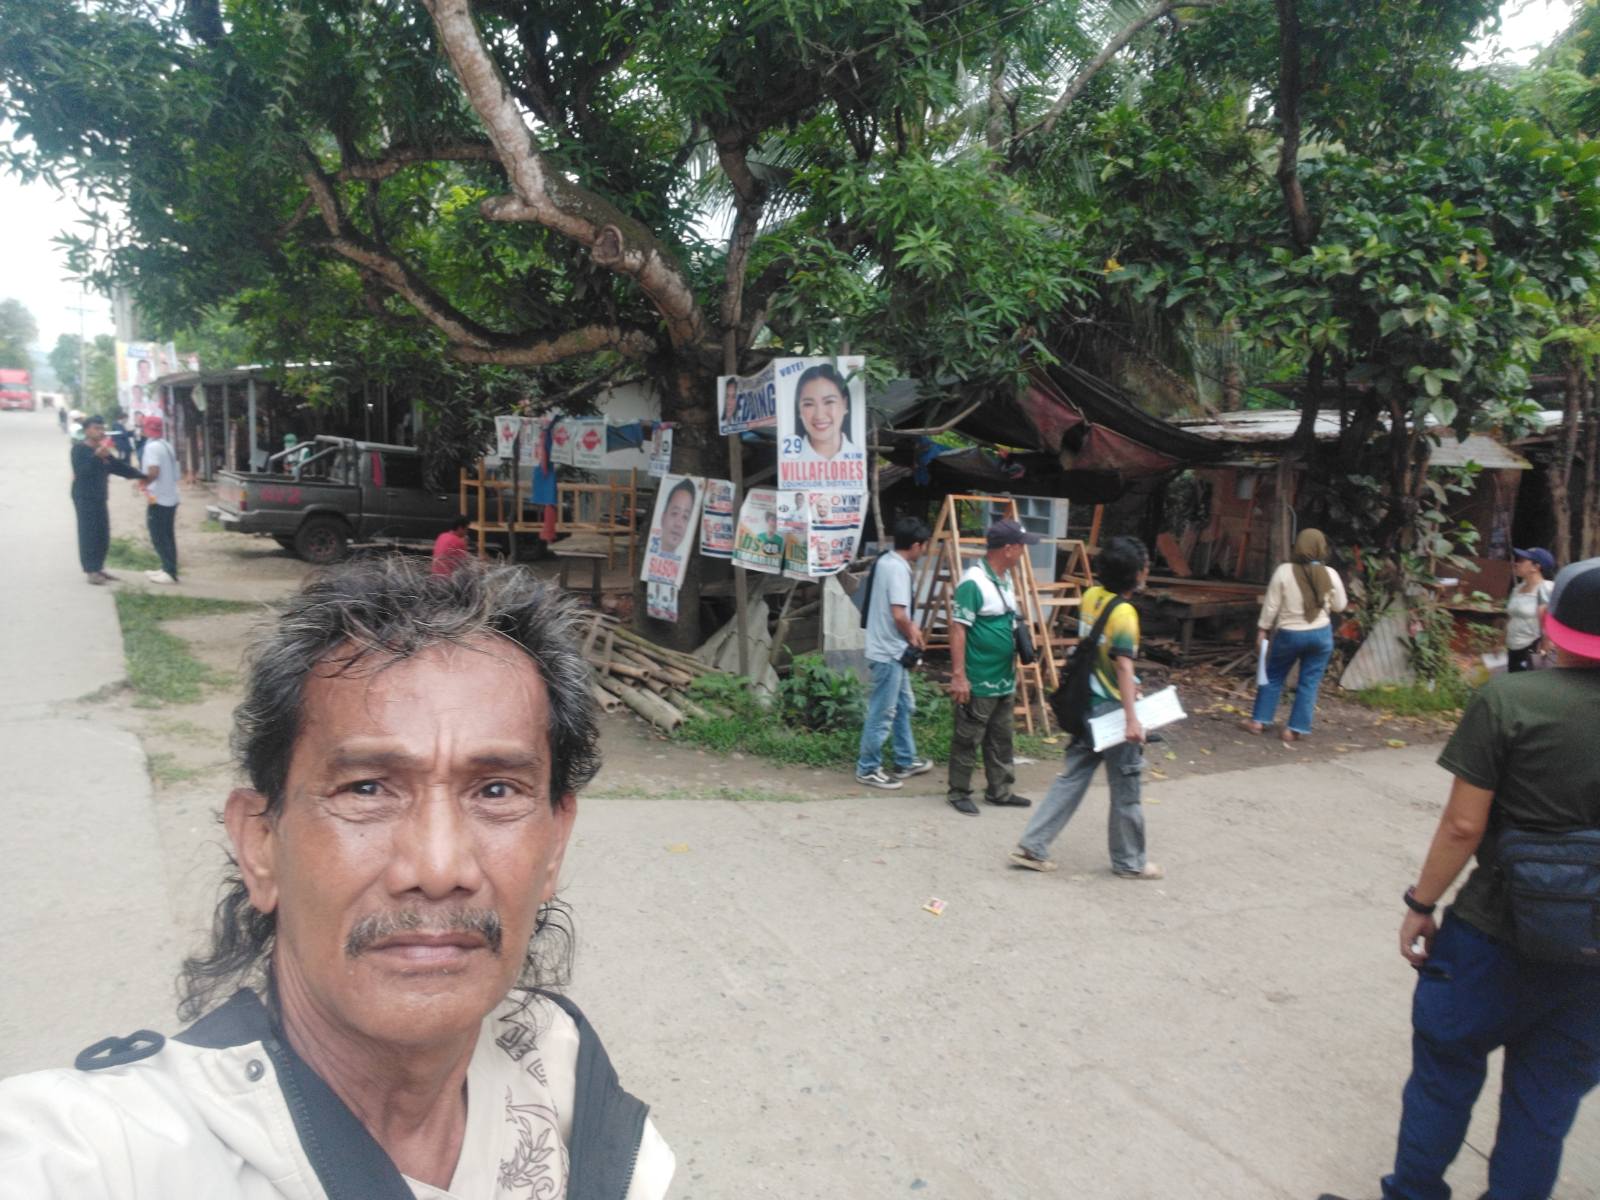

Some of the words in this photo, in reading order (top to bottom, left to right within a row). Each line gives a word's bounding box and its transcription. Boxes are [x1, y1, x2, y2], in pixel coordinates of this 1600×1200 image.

[779, 362, 804, 377] VOTE!
[783, 438, 802, 454] 29
[781, 461, 864, 481] VILLAFLORES
